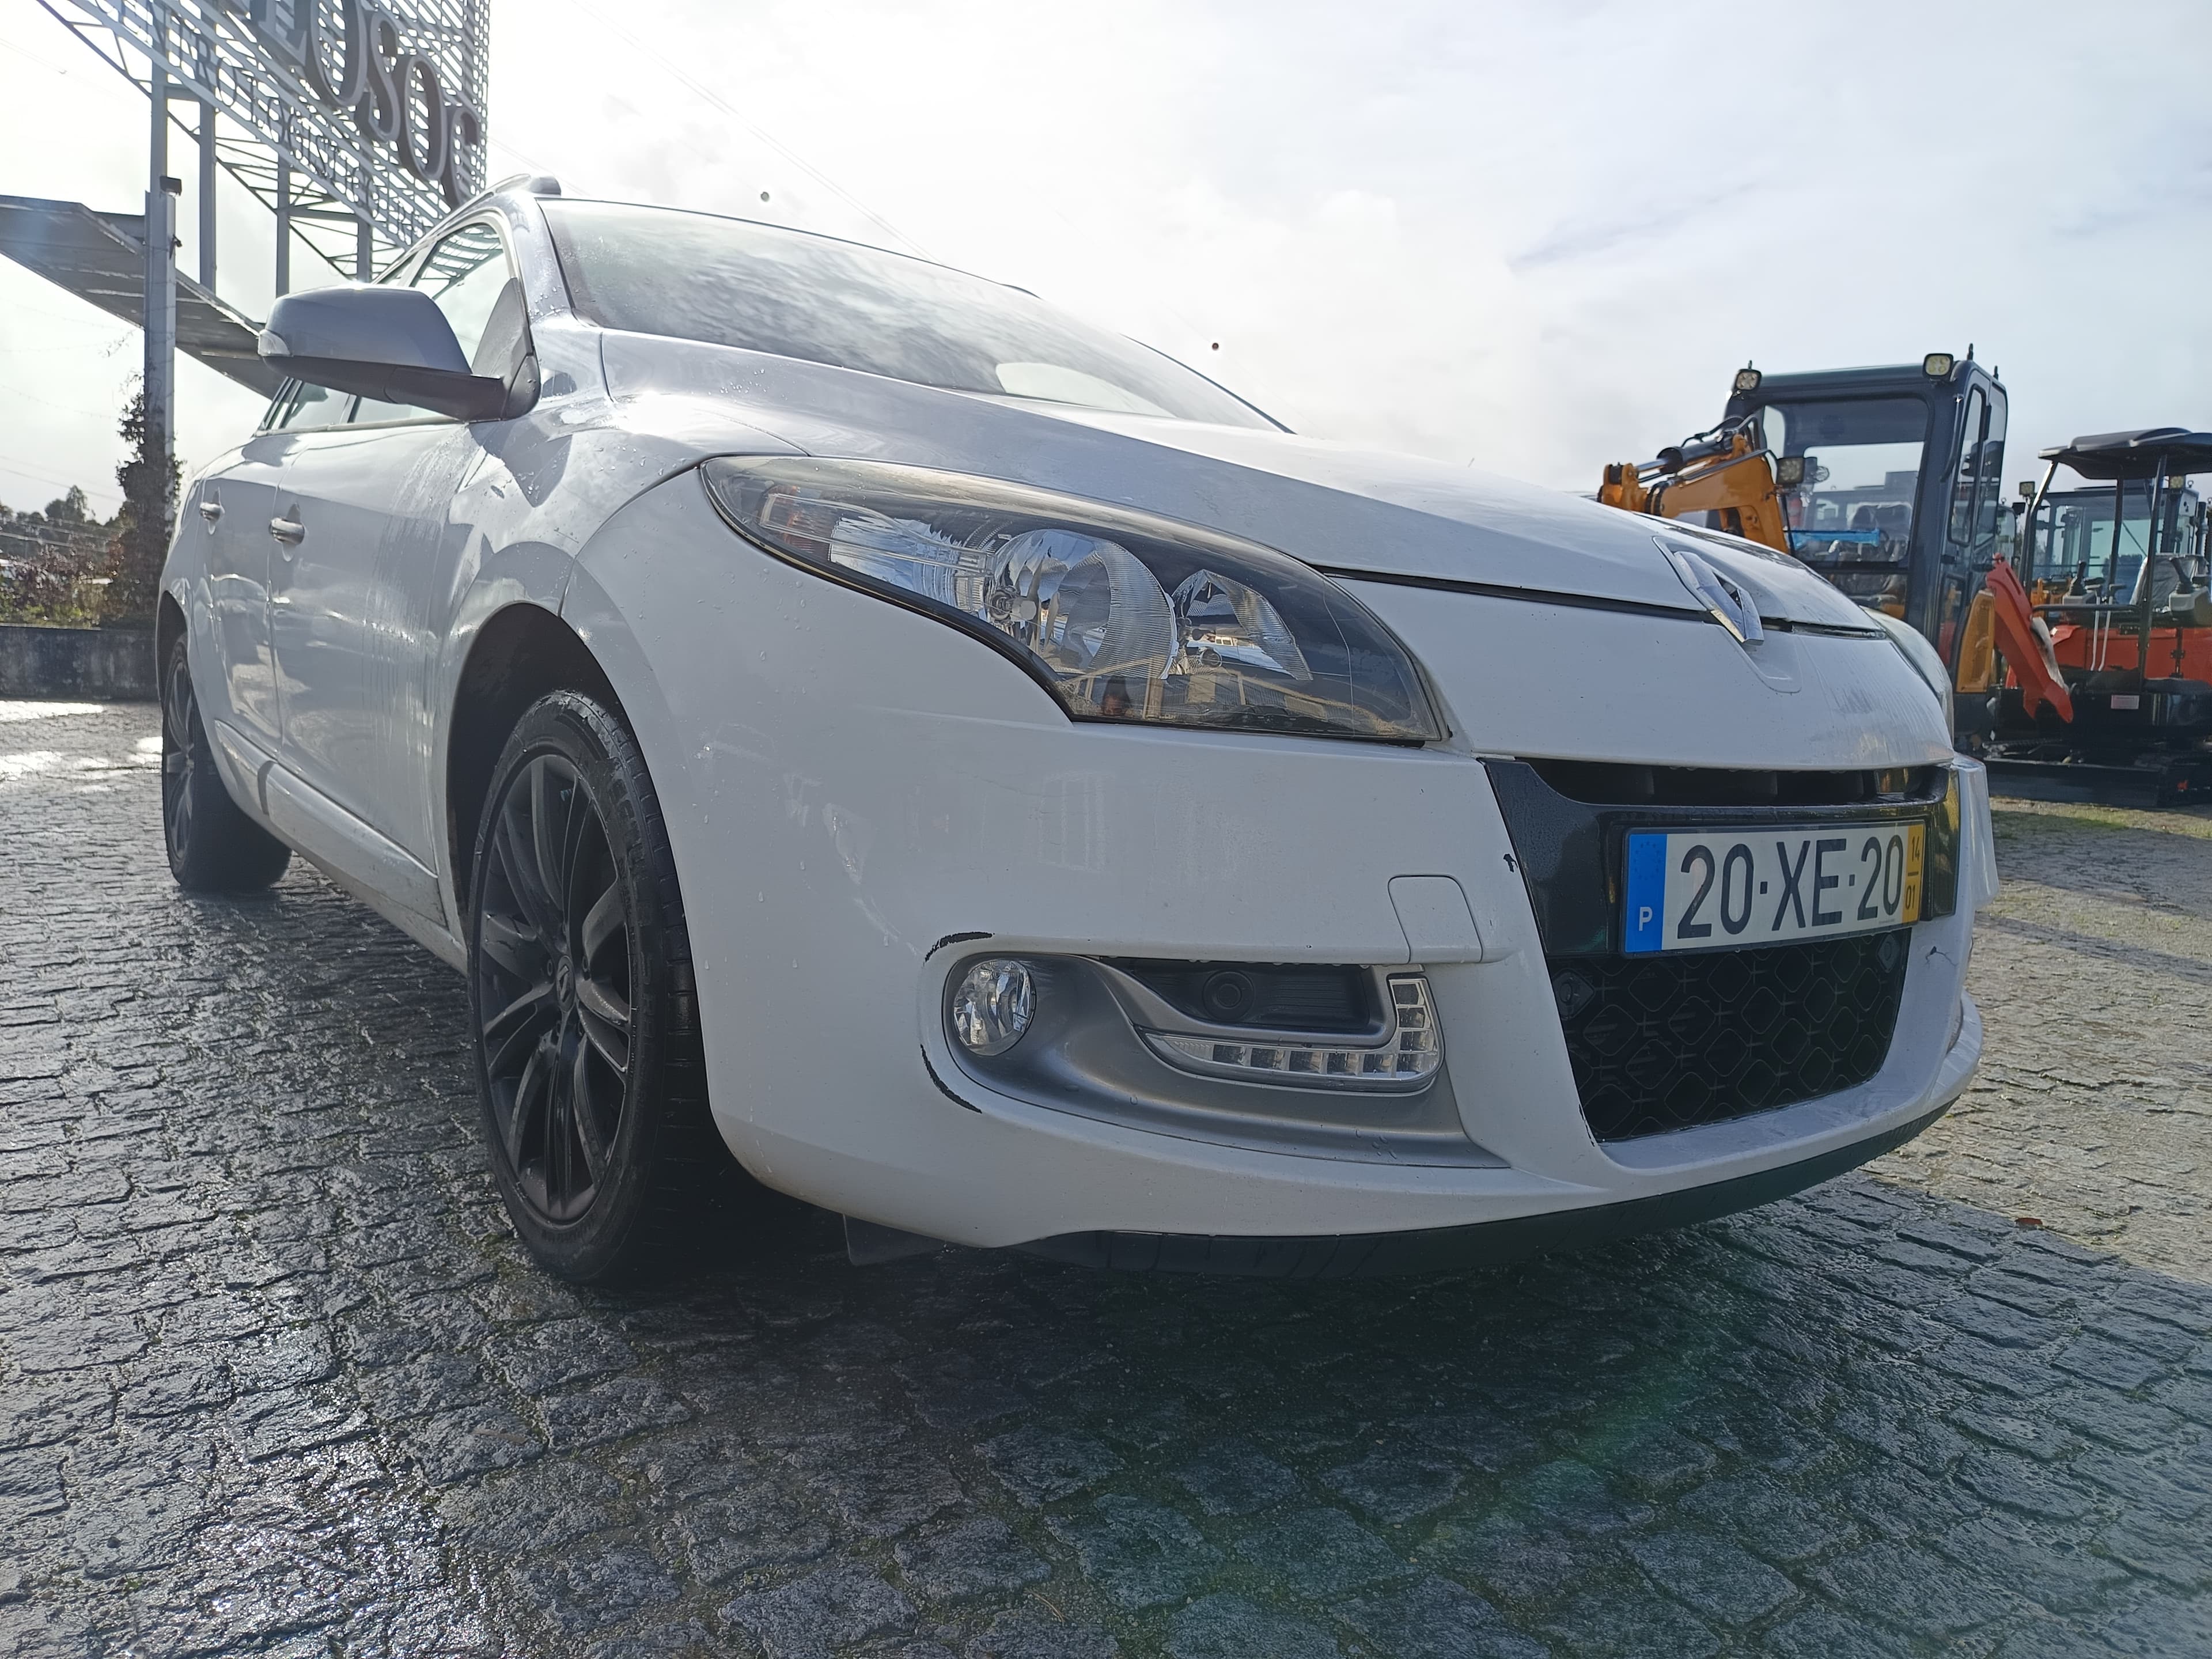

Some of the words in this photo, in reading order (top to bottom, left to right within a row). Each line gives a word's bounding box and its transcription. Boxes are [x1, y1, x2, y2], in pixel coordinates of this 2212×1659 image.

[93, 0, 238, 107] ENTRO
[1911, 836, 1920, 862] 14
[1905, 884, 1916, 910] 01
[1638, 906, 1653, 931] P
